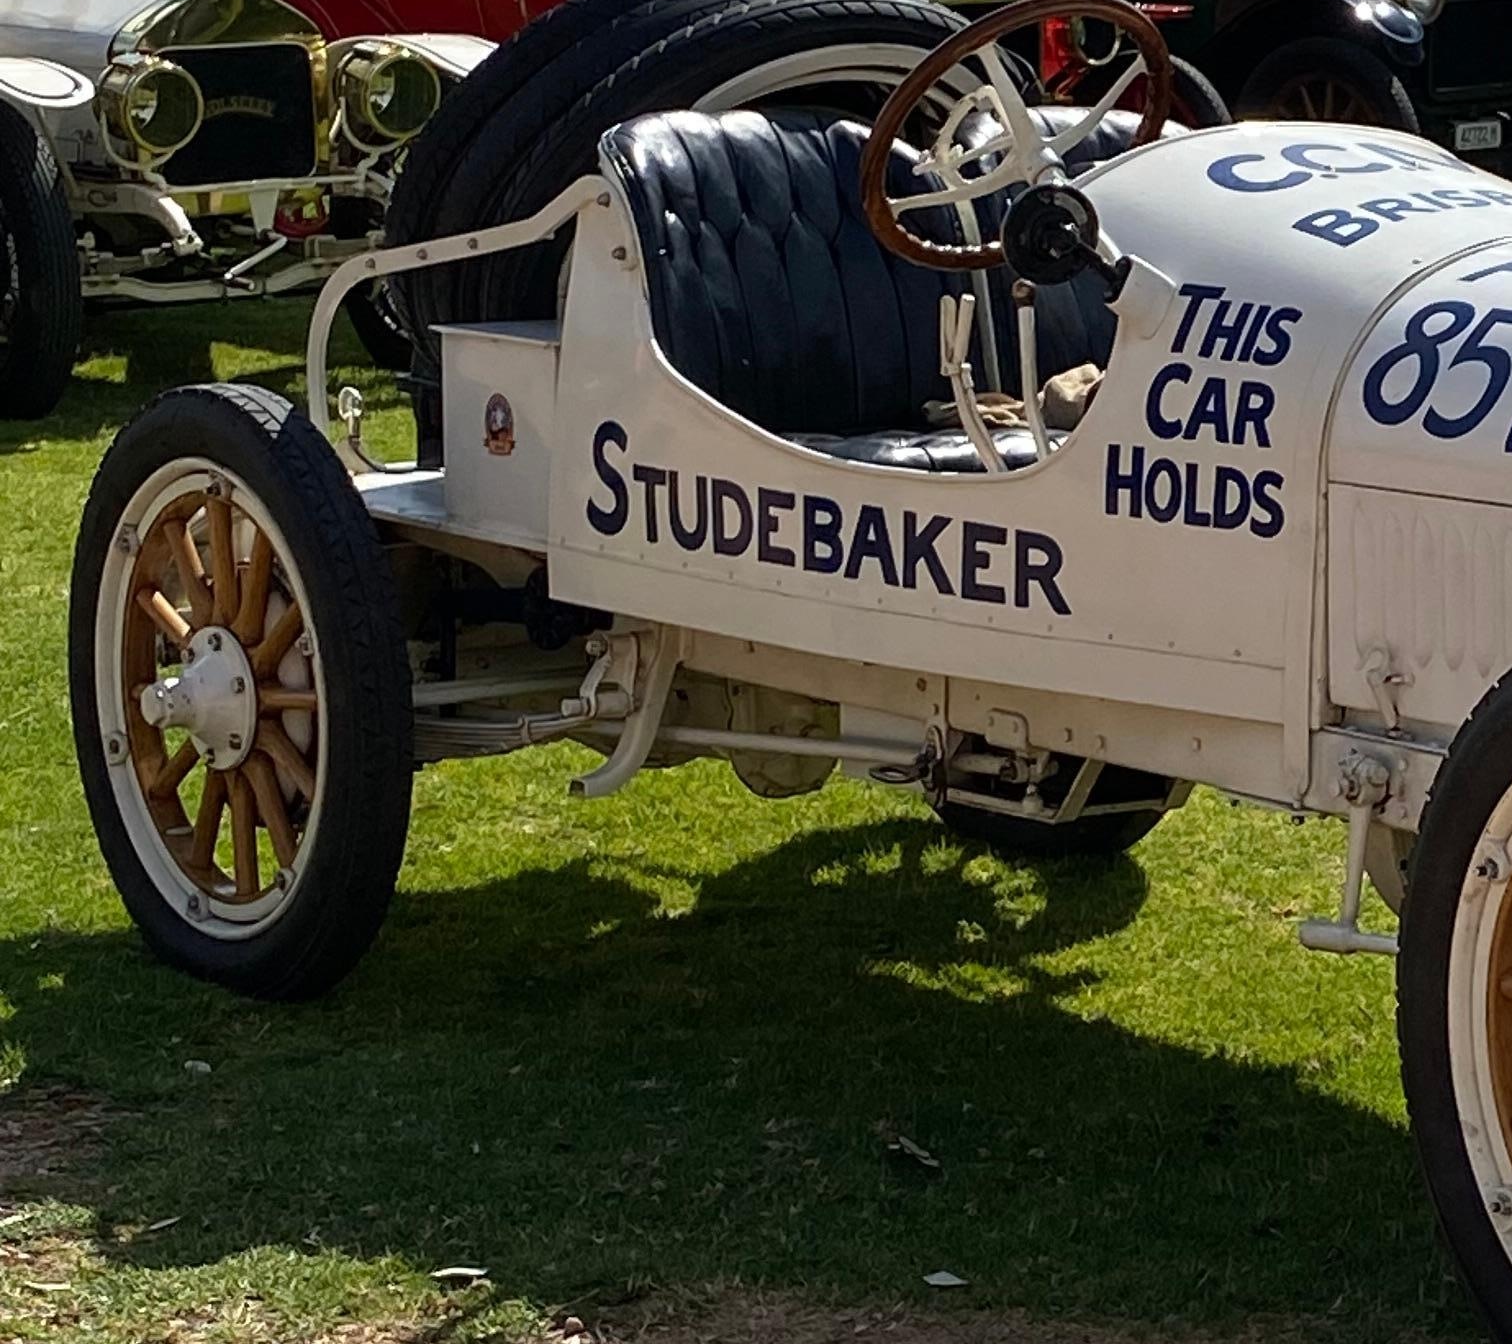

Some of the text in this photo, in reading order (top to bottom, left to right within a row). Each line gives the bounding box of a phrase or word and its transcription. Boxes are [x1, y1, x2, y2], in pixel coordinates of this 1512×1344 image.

[1170, 284, 1302, 366] THIS
[1146, 363, 1275, 448] CAR
[586, 420, 1072, 615] STUDEBAKER
[1104, 444, 1284, 538] HOLDS
